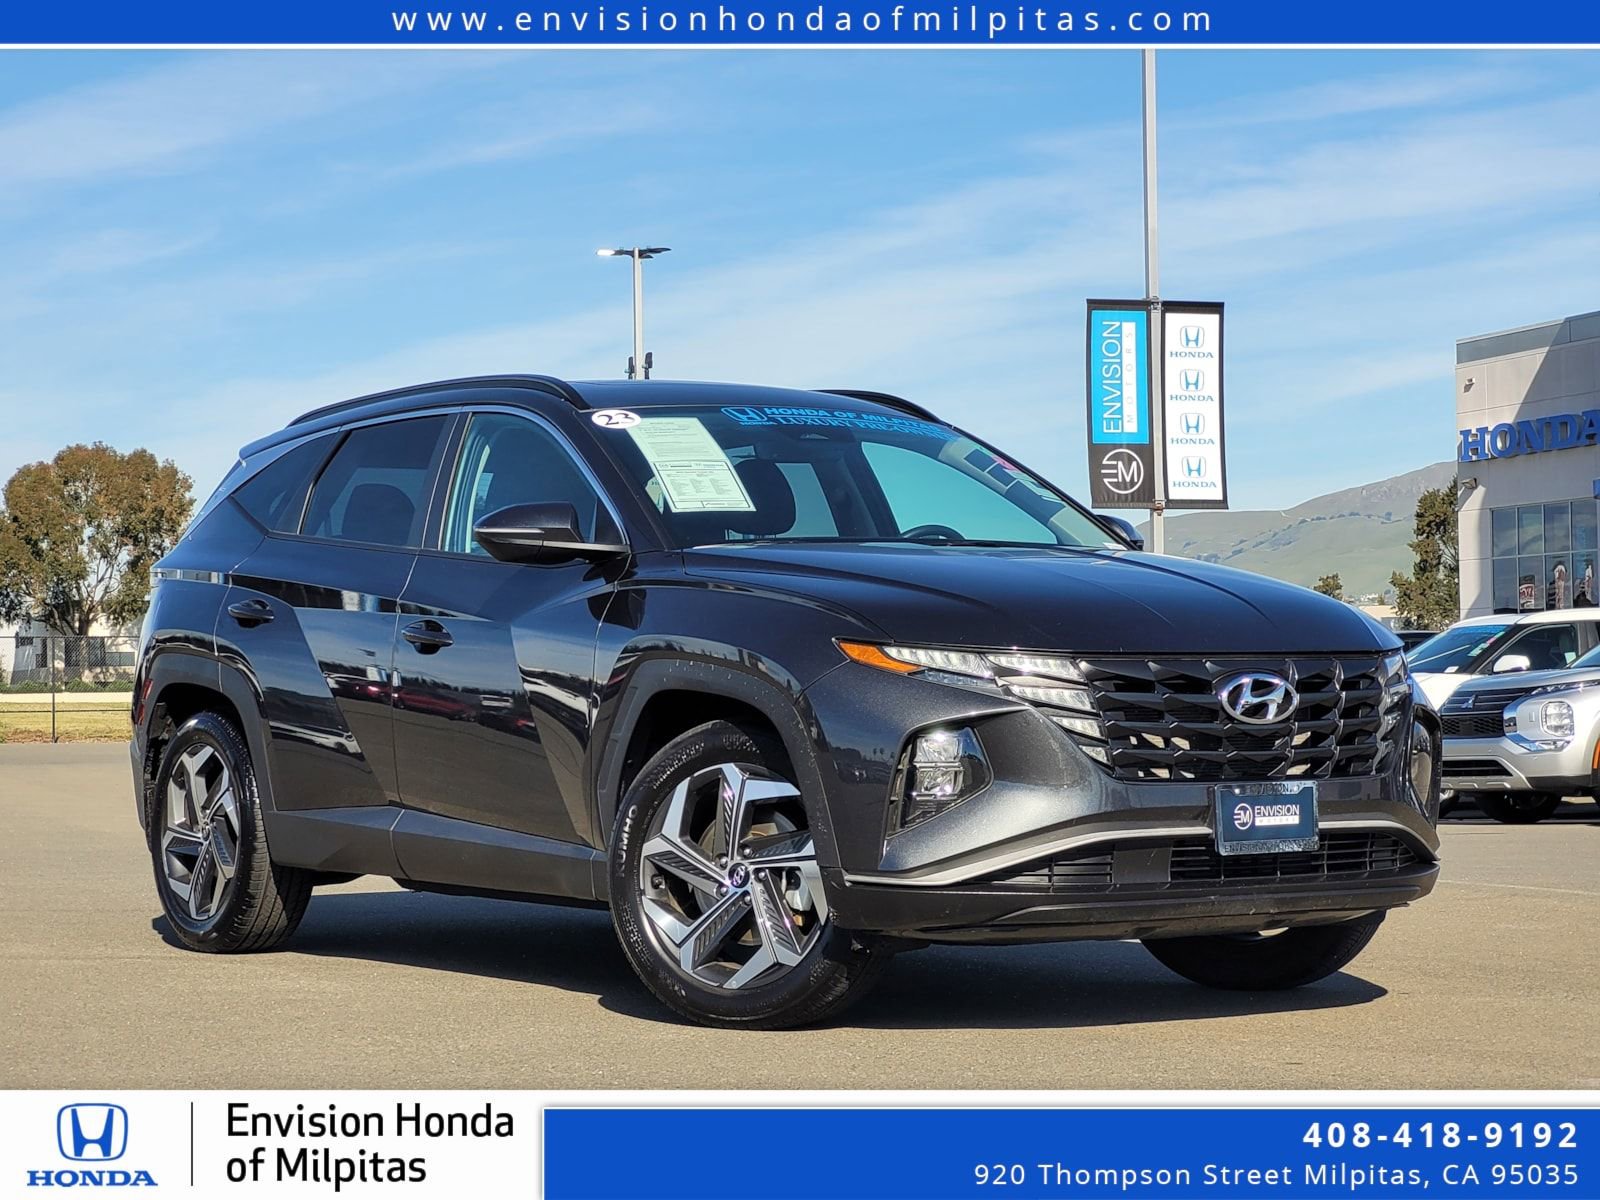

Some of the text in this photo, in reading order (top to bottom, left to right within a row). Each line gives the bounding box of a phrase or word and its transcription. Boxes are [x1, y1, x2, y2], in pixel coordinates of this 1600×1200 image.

[1169, 351, 1215, 359] HONDA
[1102, 321, 1122, 433] ENVISION
[1125, 332, 1136, 424] MOTORS
[1169, 394, 1215, 402] HONDA
[763, 407, 831, 417] HONDA
[833, 411, 858, 419] OF
[1170, 437, 1216, 445] HONDA
[1459, 409, 1600, 463] HONDA
[1172, 480, 1217, 488] HONDA
[1254, 804, 1300, 817] ENVISION
[616, 804, 638, 878] KUMHO
